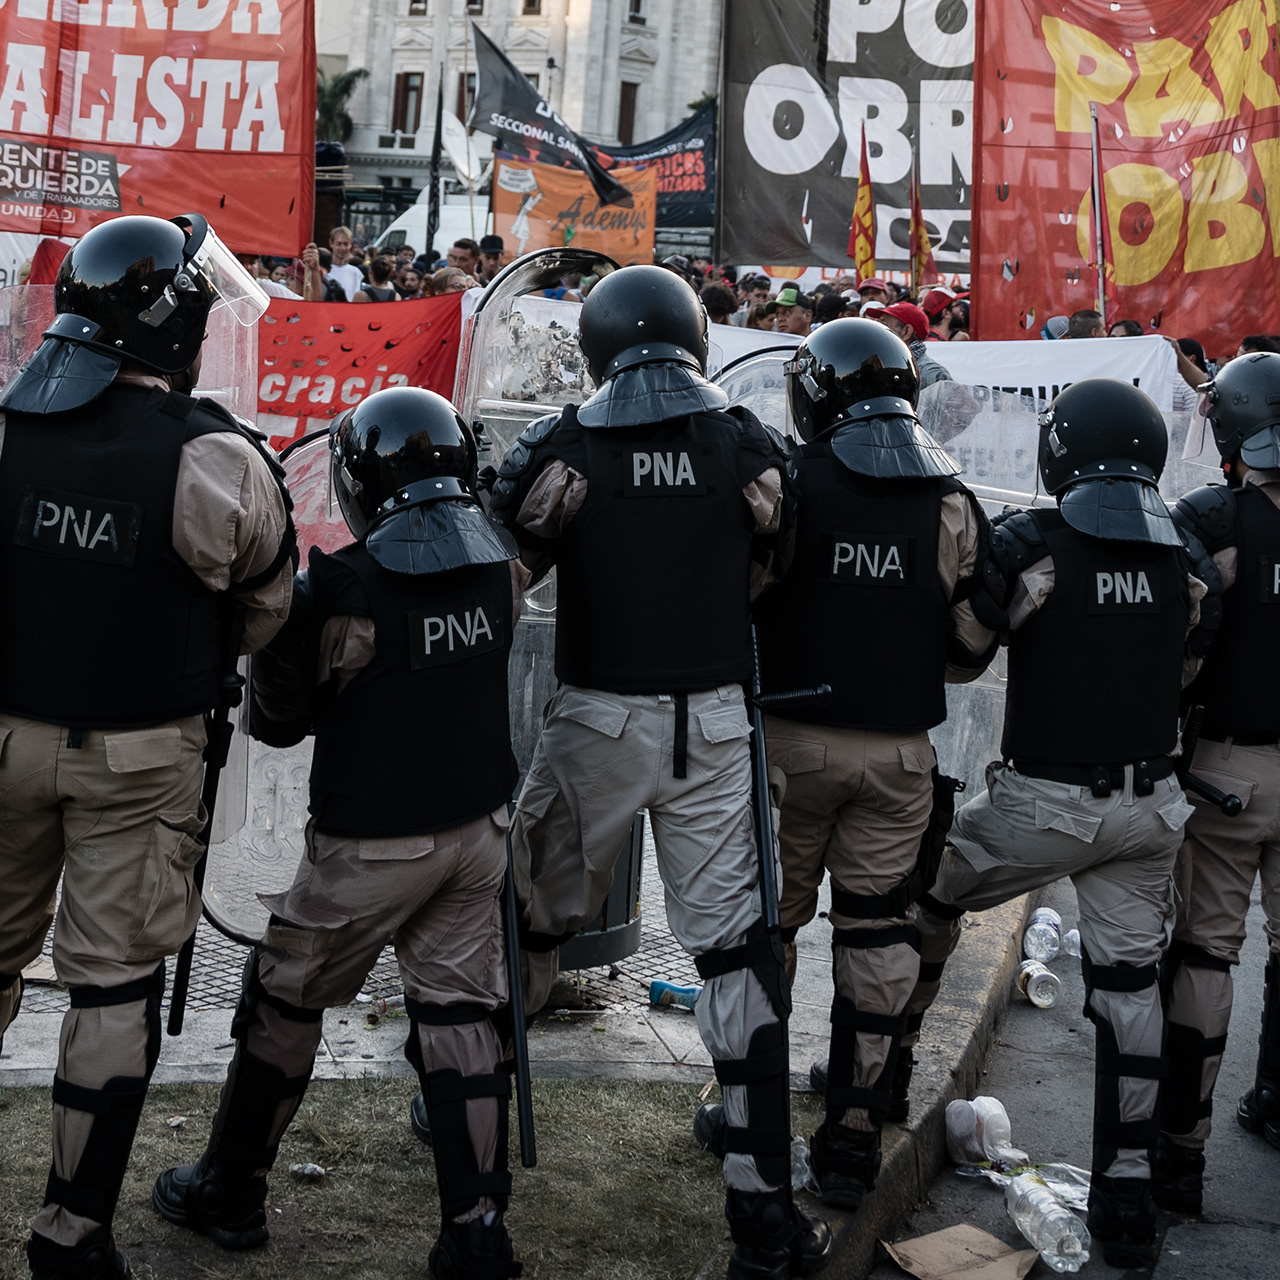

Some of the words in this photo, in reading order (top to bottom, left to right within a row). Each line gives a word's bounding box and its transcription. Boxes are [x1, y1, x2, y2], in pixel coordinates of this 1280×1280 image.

[489, 112, 556, 146] SECCIONAL
[743, 62, 976, 186] OBR
[81, 157, 110, 176] DE
[1, 204, 74, 221] UNIDAD
[14, 189, 22, 198] Y
[23, 190, 39, 200] DE
[41, 192, 119, 208] TRABAJADORES
[550, 194, 649, 241] Ademys
[633, 452, 697, 487] PNA
[35, 500, 119, 553] PNA
[832, 543, 904, 580] PNA
[1096, 571, 1154, 605] PNA
[423, 606, 494, 656] PNA
